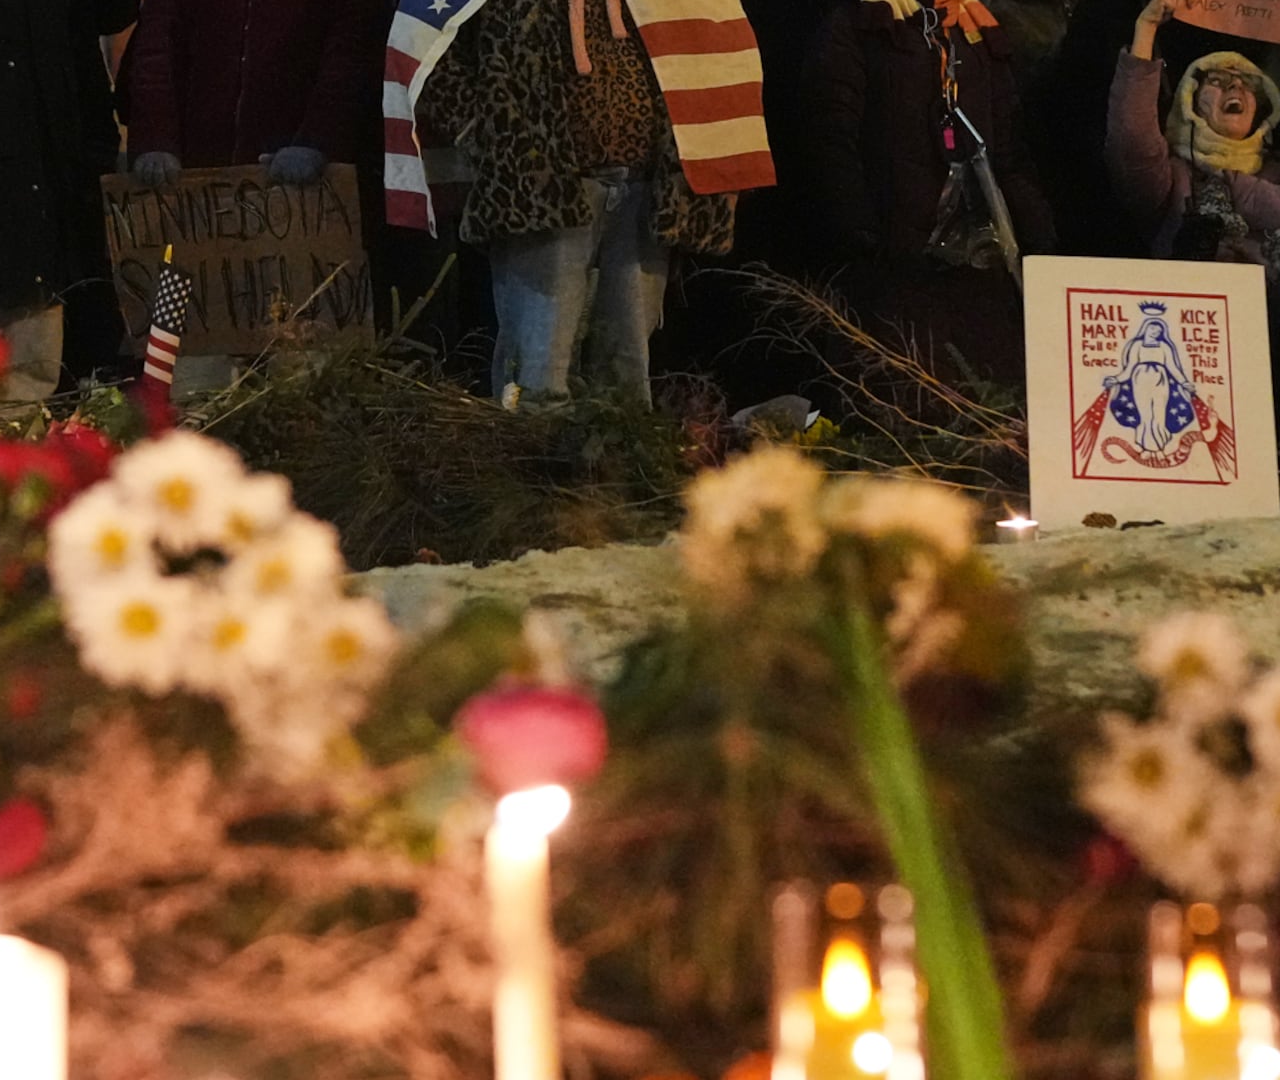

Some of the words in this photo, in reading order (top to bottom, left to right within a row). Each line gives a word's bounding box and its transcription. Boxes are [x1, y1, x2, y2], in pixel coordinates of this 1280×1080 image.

[1080, 303, 1129, 322] HAIL
[1180, 309, 1218, 326] KICK
[1082, 324, 1129, 340] MARY
[1082, 340, 1104, 352] Full
[1082, 354, 1119, 368] Grace
[1189, 354, 1218, 368] This
[1192, 369, 1225, 385] Place
